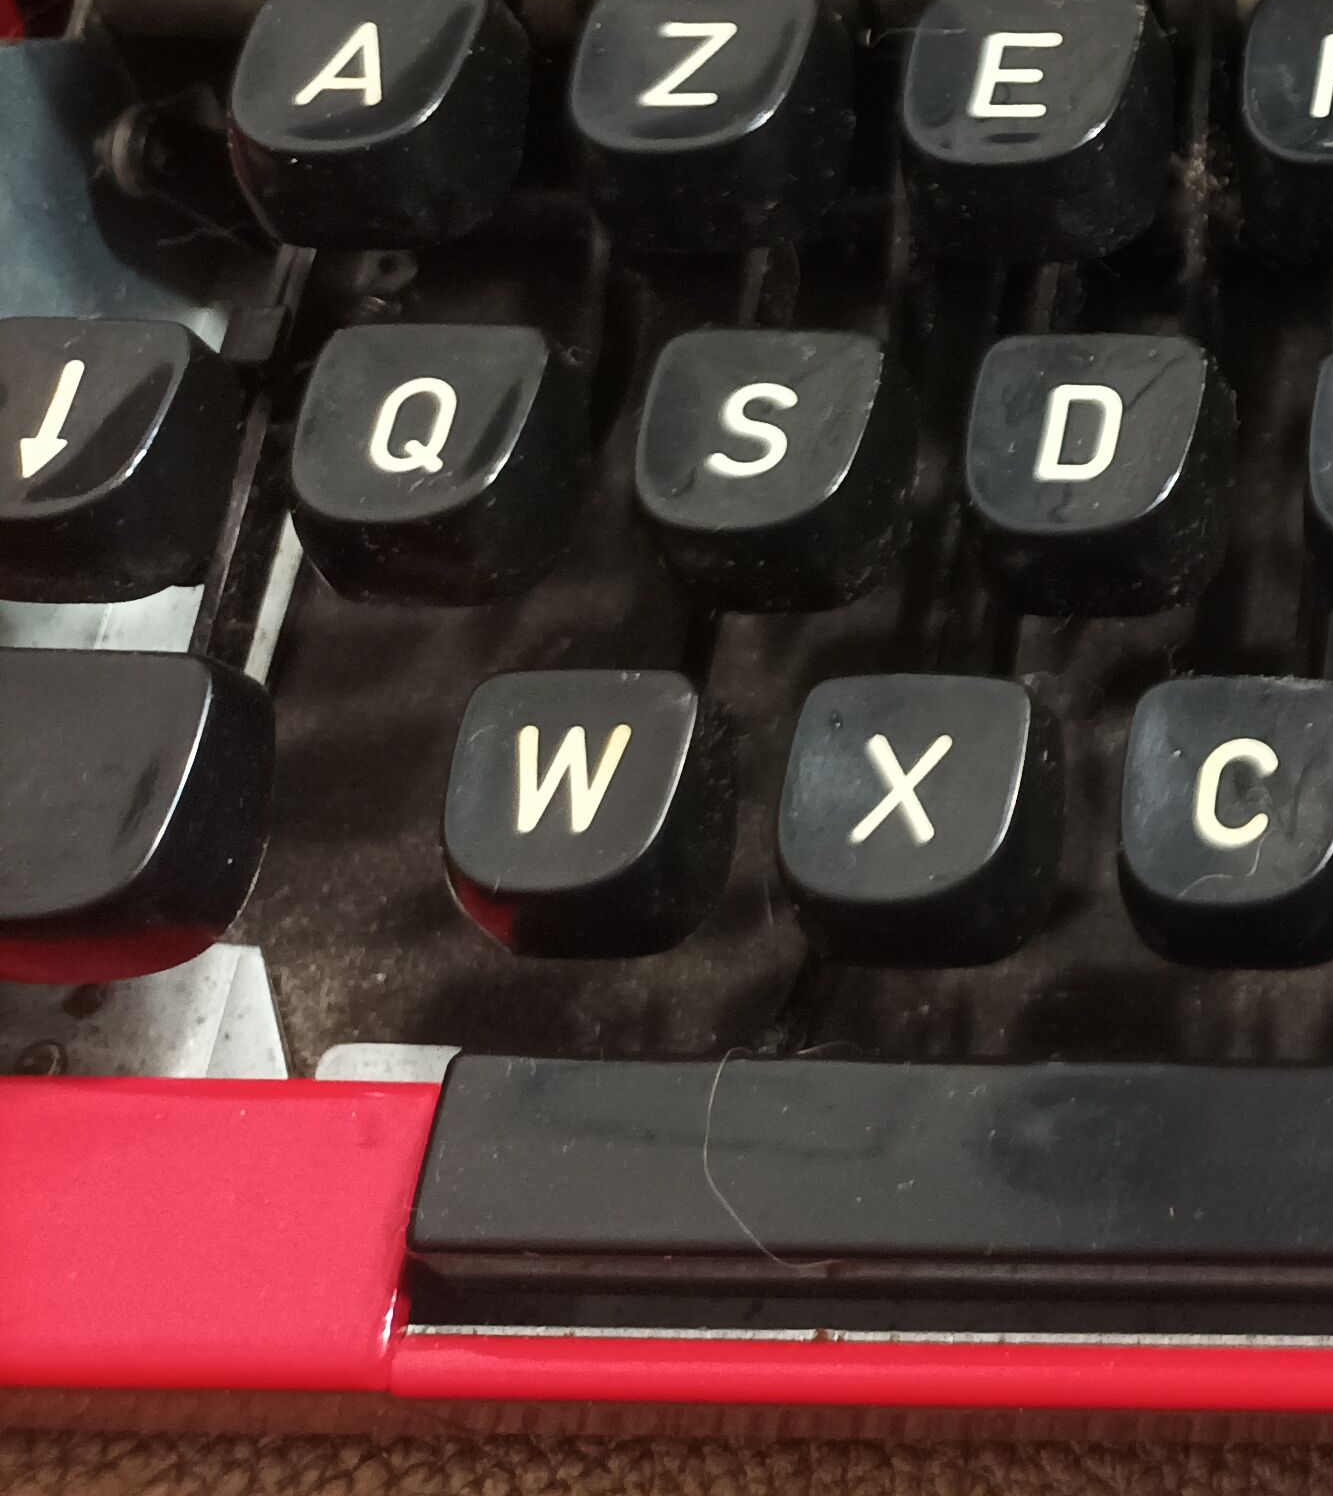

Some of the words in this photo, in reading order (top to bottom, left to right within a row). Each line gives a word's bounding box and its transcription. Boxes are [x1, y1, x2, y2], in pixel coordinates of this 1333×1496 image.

[294, 21, 382, 106] A
[638, 22, 738, 107] Z
[969, 32, 1063, 118] E
[369, 377, 457, 473] Q
[706, 382, 799, 478] S
[1034, 384, 1123, 481] D
[516, 724, 632, 834] W
[850, 733, 953, 844] X
[1195, 738, 1279, 848] C
